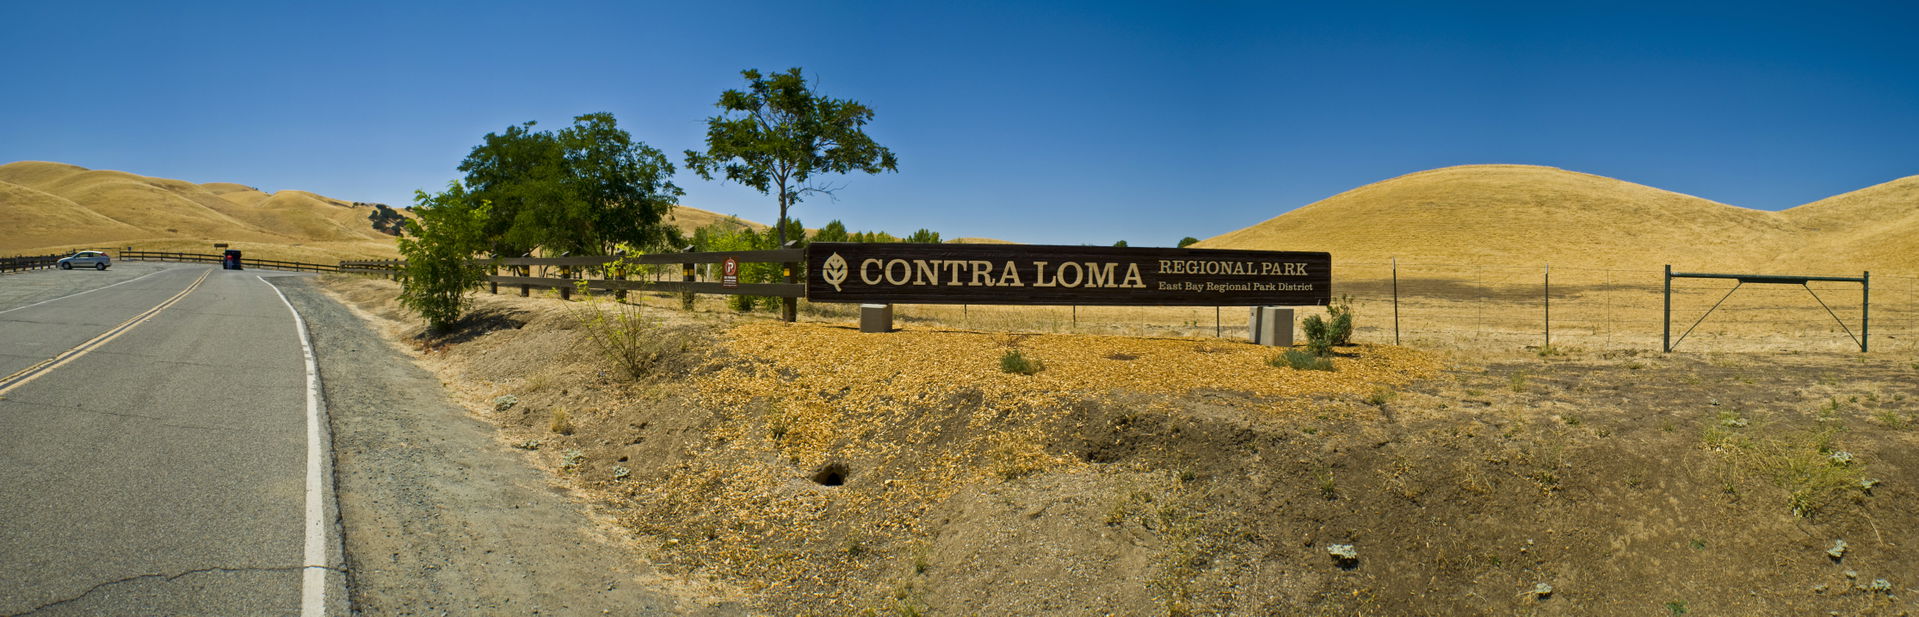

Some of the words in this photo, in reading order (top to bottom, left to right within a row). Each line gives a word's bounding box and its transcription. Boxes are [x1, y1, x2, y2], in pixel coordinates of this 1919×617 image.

[860, 258, 1025, 287] CONTRA
[1032, 261, 1147, 289] LOMA
[1158, 260, 1258, 276] REGIONAL
[1261, 262, 1308, 276] PARK
[1158, 281, 1182, 291] East
[1185, 281, 1204, 293] Bay
[1206, 281, 1251, 293] Regional
[1253, 282, 1276, 291] Park
[1278, 282, 1313, 291] District
